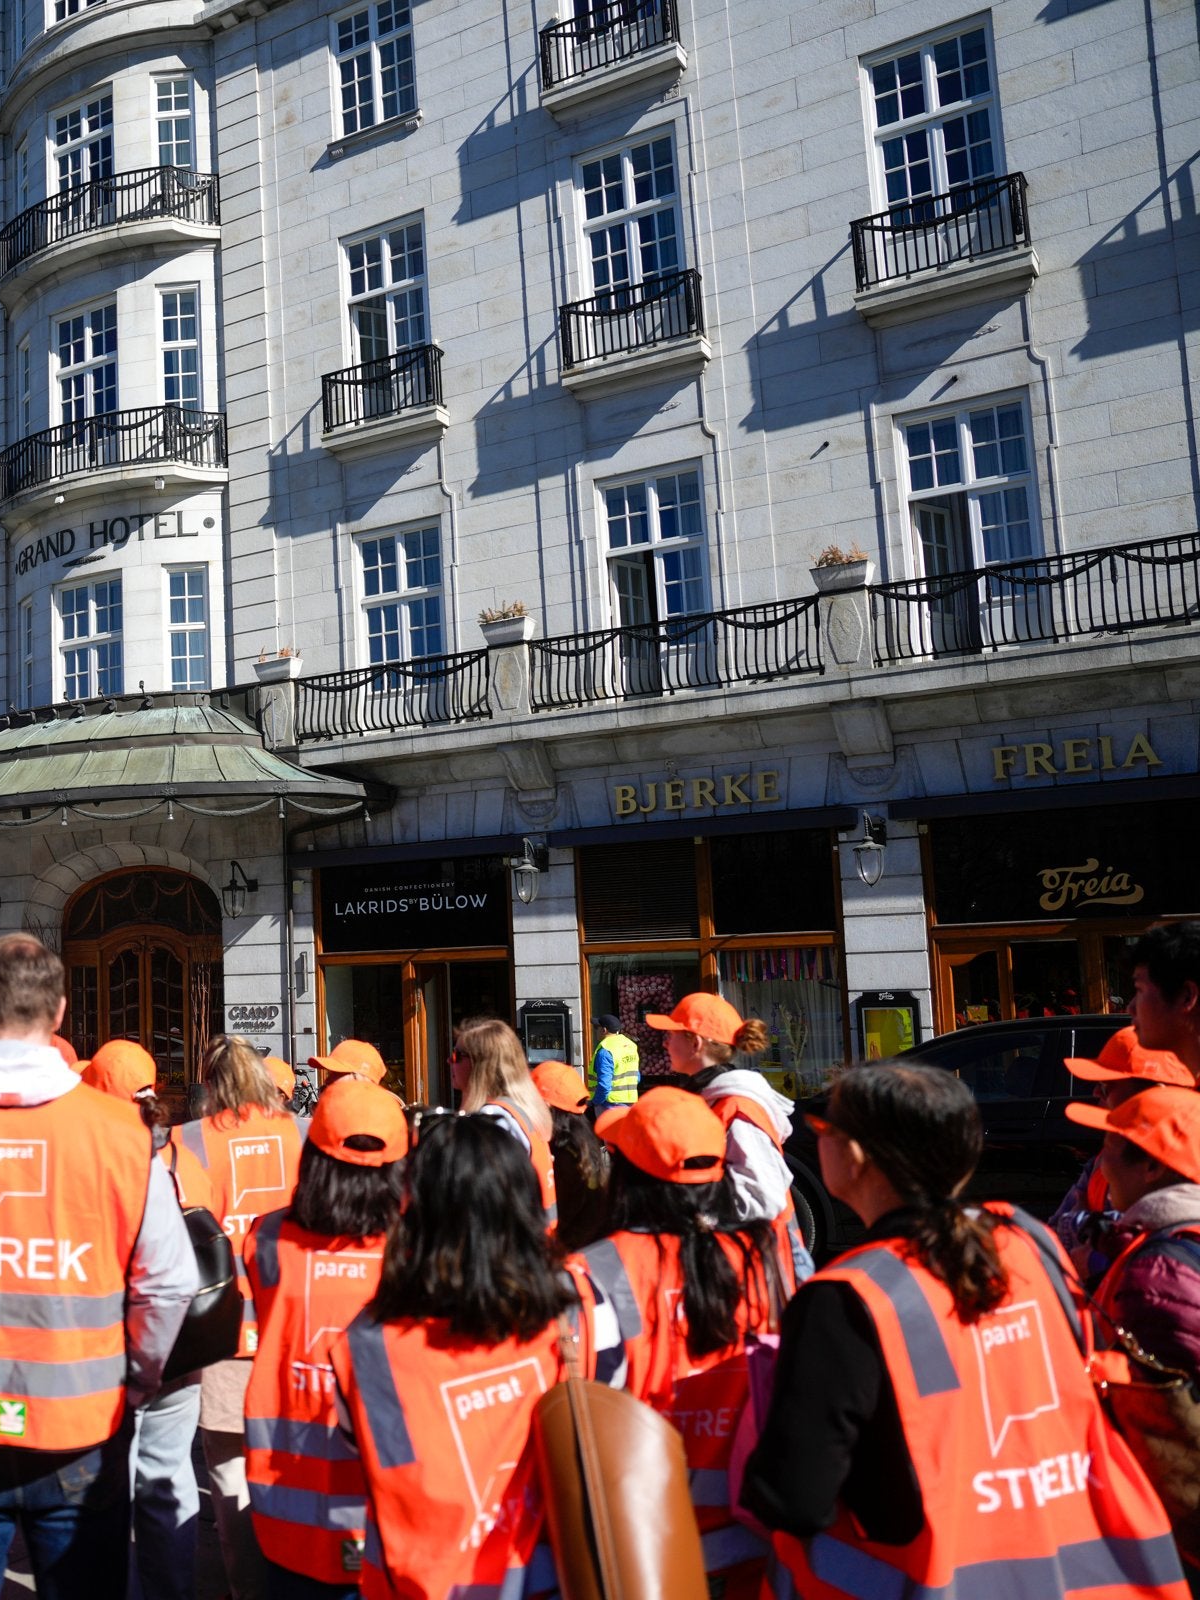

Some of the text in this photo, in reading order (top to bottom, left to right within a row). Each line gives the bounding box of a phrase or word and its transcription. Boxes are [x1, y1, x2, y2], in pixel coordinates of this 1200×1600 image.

[18, 511, 199, 576] GRAND HOTEL
[991, 732, 1164, 780] FREIA
[614, 770, 781, 815] BJERKE
[394, 882, 456, 891] CONFECTIONERY
[1036, 857, 1145, 912] Freia
[335, 899, 409, 916] LAKRIDS
[419, 893, 488, 911] BÜLOW
[228, 1005, 280, 1021] GRAND
[235, 1142, 271, 1160] parat
[314, 1260, 368, 1281] parat
[456, 1375, 523, 1421] parat
